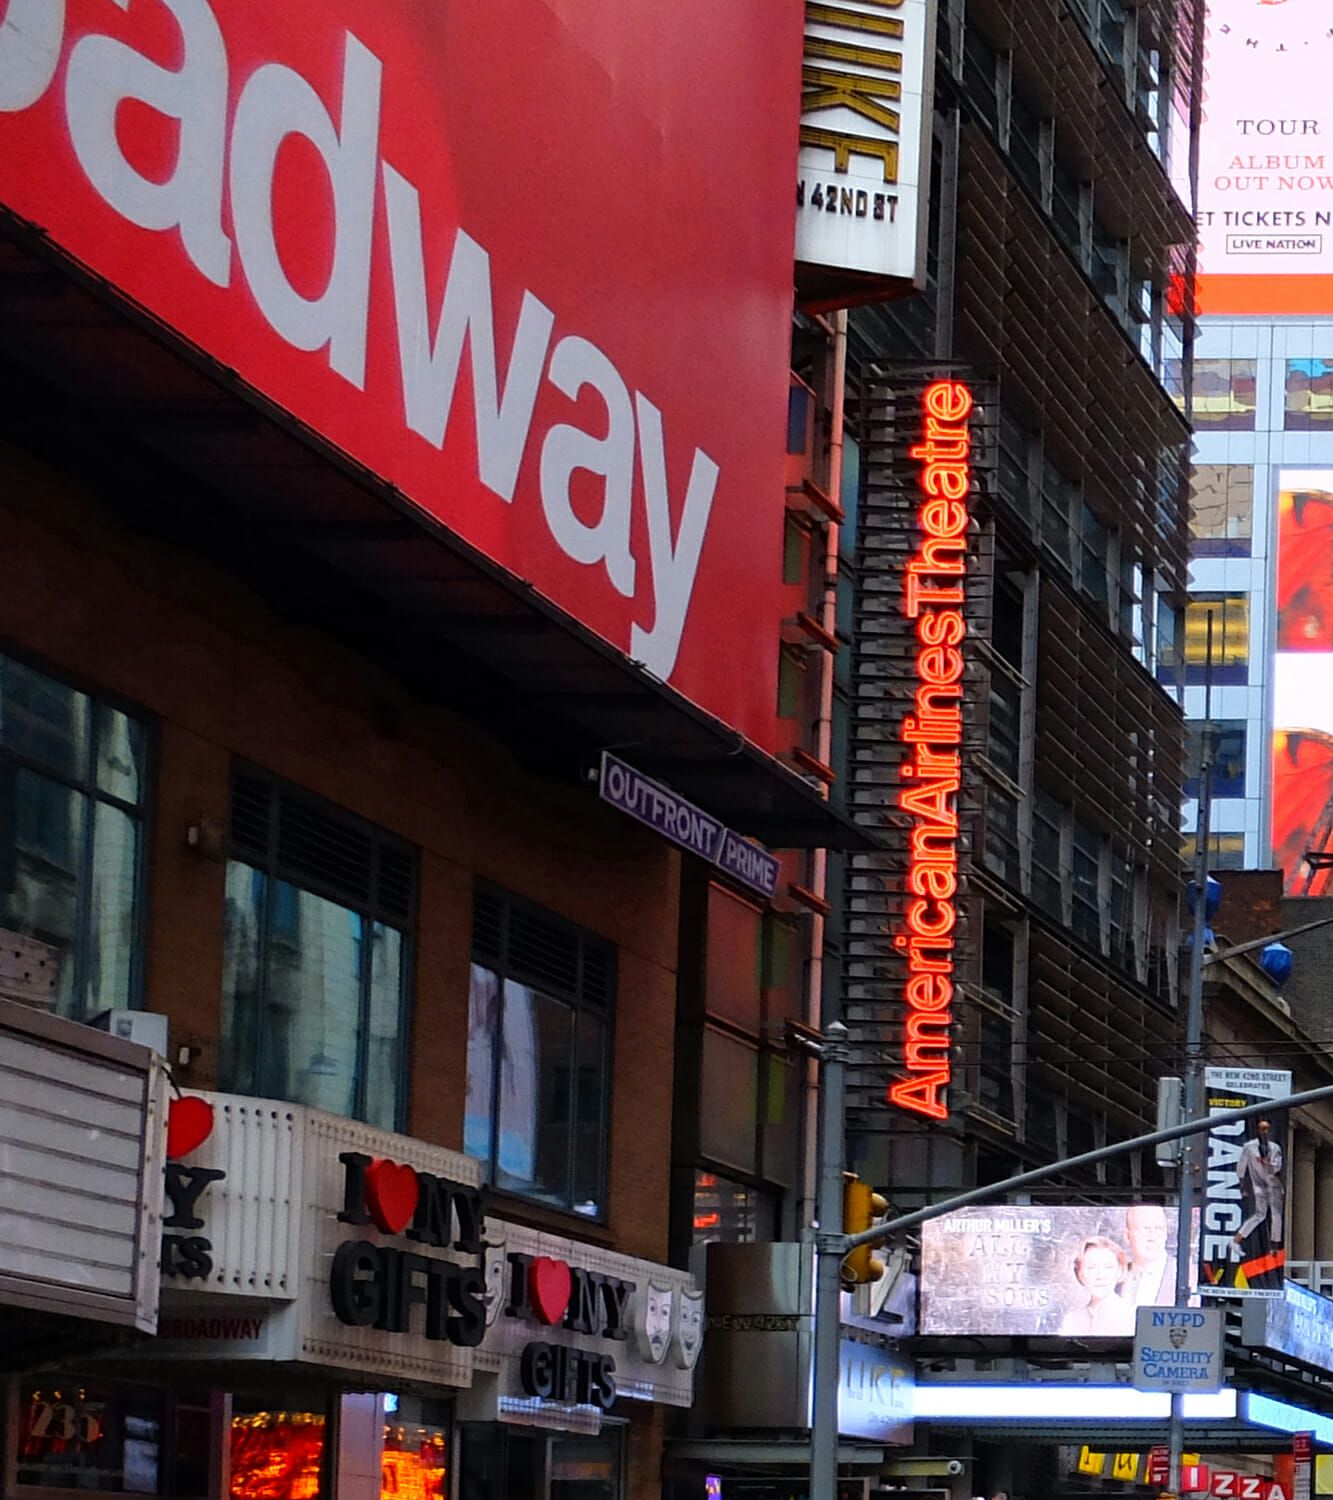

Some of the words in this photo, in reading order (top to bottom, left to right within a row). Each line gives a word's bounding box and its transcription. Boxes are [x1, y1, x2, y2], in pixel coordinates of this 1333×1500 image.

[1236, 119, 1321, 136] TOUR
[1228, 155, 1326, 170] ALBUM
[1214, 176, 1269, 191] OUT
[1222, 211, 1306, 227] TICKETS
[1231, 239, 1262, 250] LIVE
[1266, 239, 1316, 249] NATION
[608, 763, 717, 855] OUTFRONT
[725, 836, 776, 892] PRIME
[1203, 1107, 1247, 1263] DANCE
[406, 1172, 488, 1254] NY
[943, 1218, 993, 1234] ARTHUR
[994, 1219, 1052, 1234] MILLER'S
[968, 1234, 1031, 1258] ALL
[329, 1239, 488, 1348] GIFTS
[984, 1286, 1052, 1308] SONS
[563, 1267, 637, 1341] NY
[1152, 1311, 1206, 1328] NYPD
[1141, 1346, 1215, 1364] SECURITY
[520, 1341, 617, 1410] GIFTS
[1143, 1362, 1208, 1379] CAMERA
